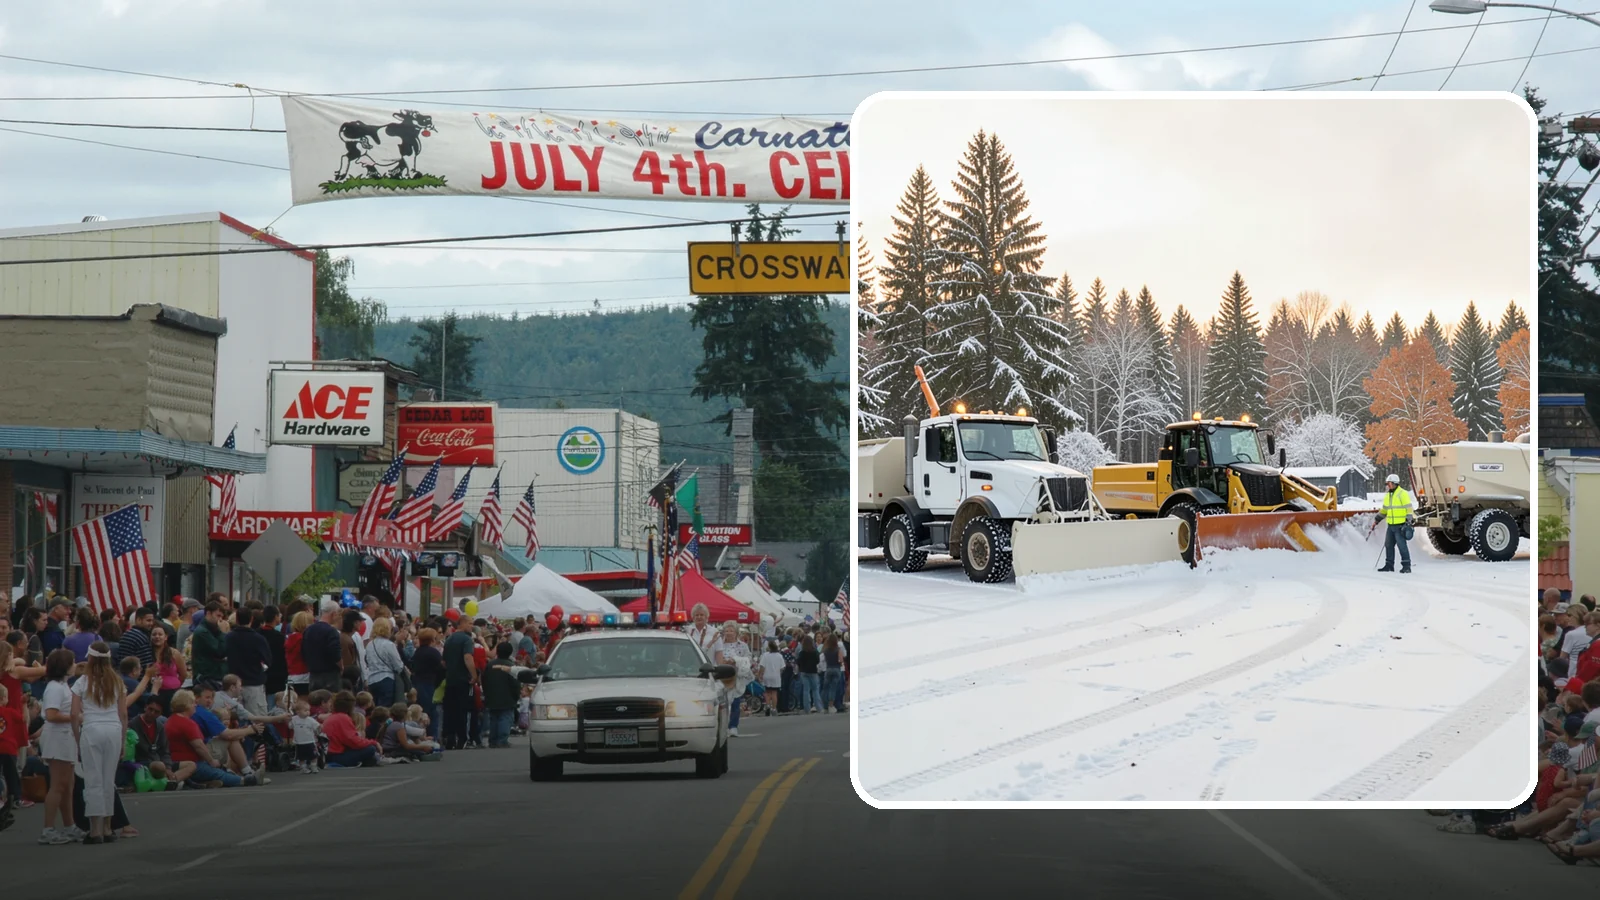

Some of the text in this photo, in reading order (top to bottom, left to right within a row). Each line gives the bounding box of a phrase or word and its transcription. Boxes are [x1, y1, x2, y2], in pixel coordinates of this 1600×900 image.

[481, 141, 605, 192] JULY
[632, 150, 746, 198] 4th.
[697, 254, 850, 280] CROSSWA
[283, 380, 373, 420] ACE
[405, 409, 485, 421] CEDAR LOG
[284, 421, 370, 436] Hardware
[416, 428, 476, 446] Coca-Cola
[354, 467, 385, 480] Simpl
[96, 485, 124, 494] Vincent
[126, 486, 135, 494] de
[138, 486, 155, 495] Paul
[688, 527, 741, 535] CRNATION
[699, 535, 730, 543] GLASS
